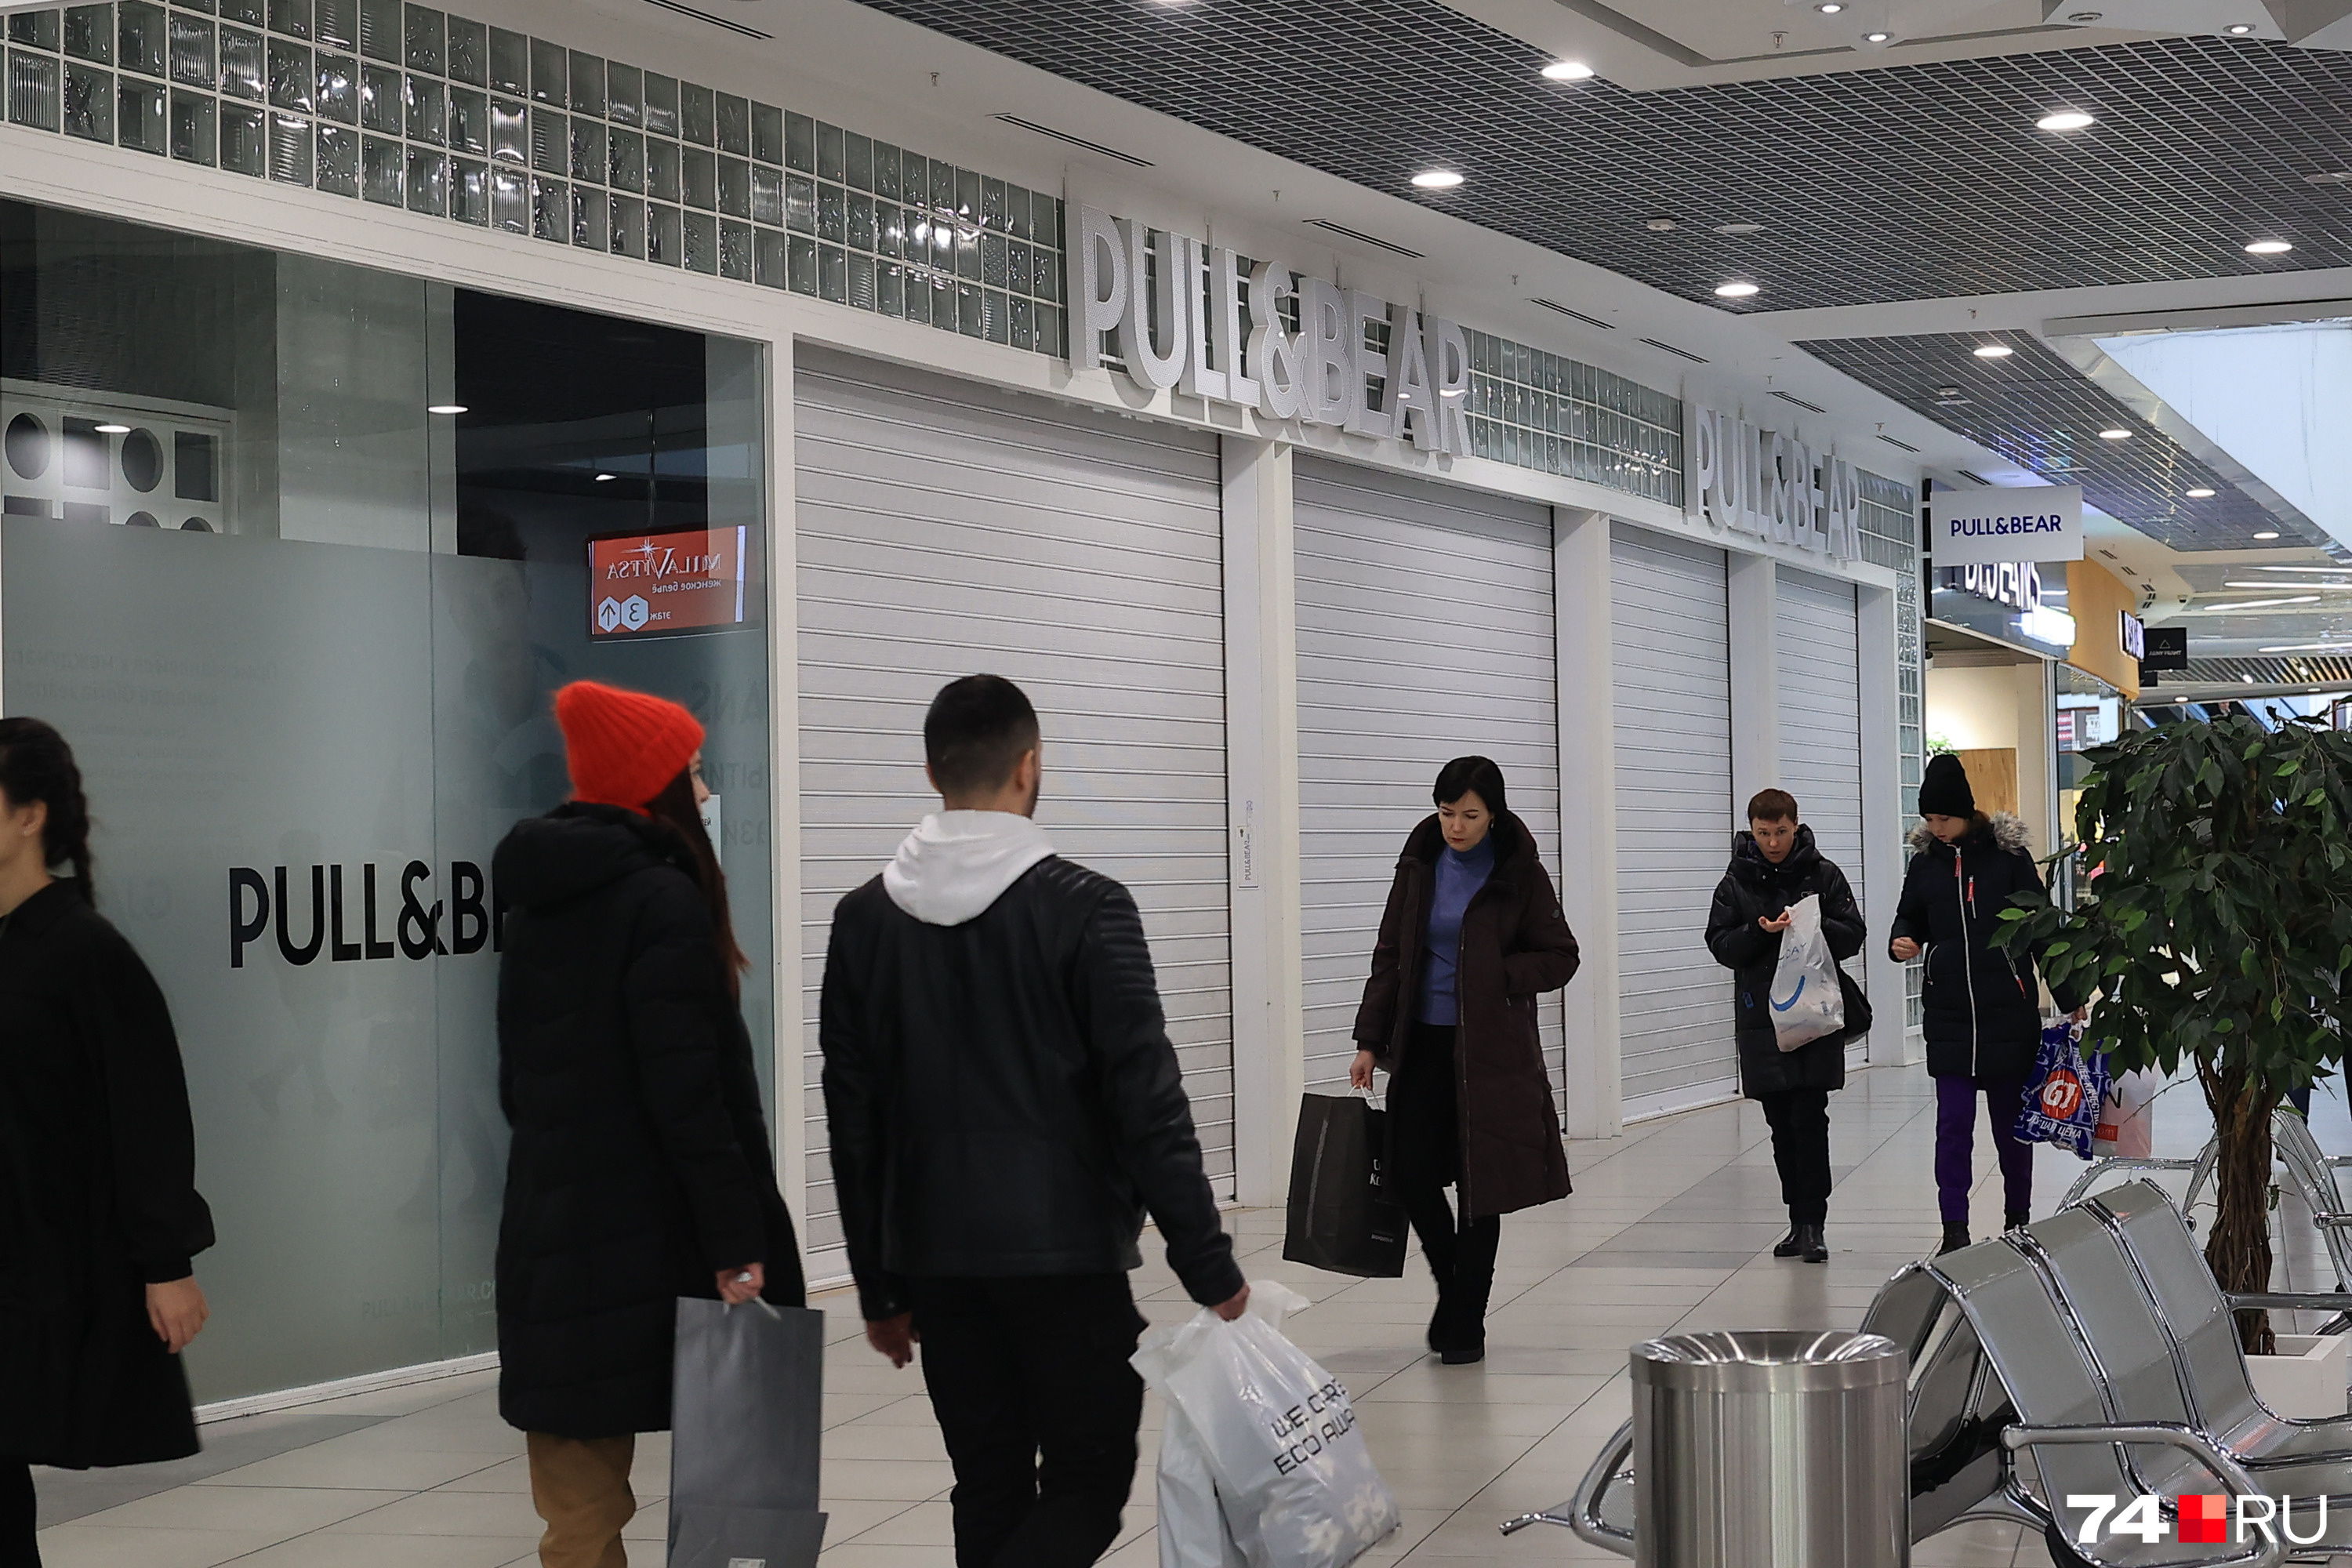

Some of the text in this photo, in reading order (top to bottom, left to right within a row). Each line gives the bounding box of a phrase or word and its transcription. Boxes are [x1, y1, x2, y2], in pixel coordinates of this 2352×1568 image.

[1068, 201, 1473, 460] PULL&BEAR
[1687, 403, 1864, 563] PULL&BEAR
[1950, 514, 2063, 538] PULL&BEAR
[2056, 1124, 2082, 1139] ЦЕНА
[1271, 1404, 1309, 1439] WE
[1273, 1408, 1356, 1475] ECO AWA
